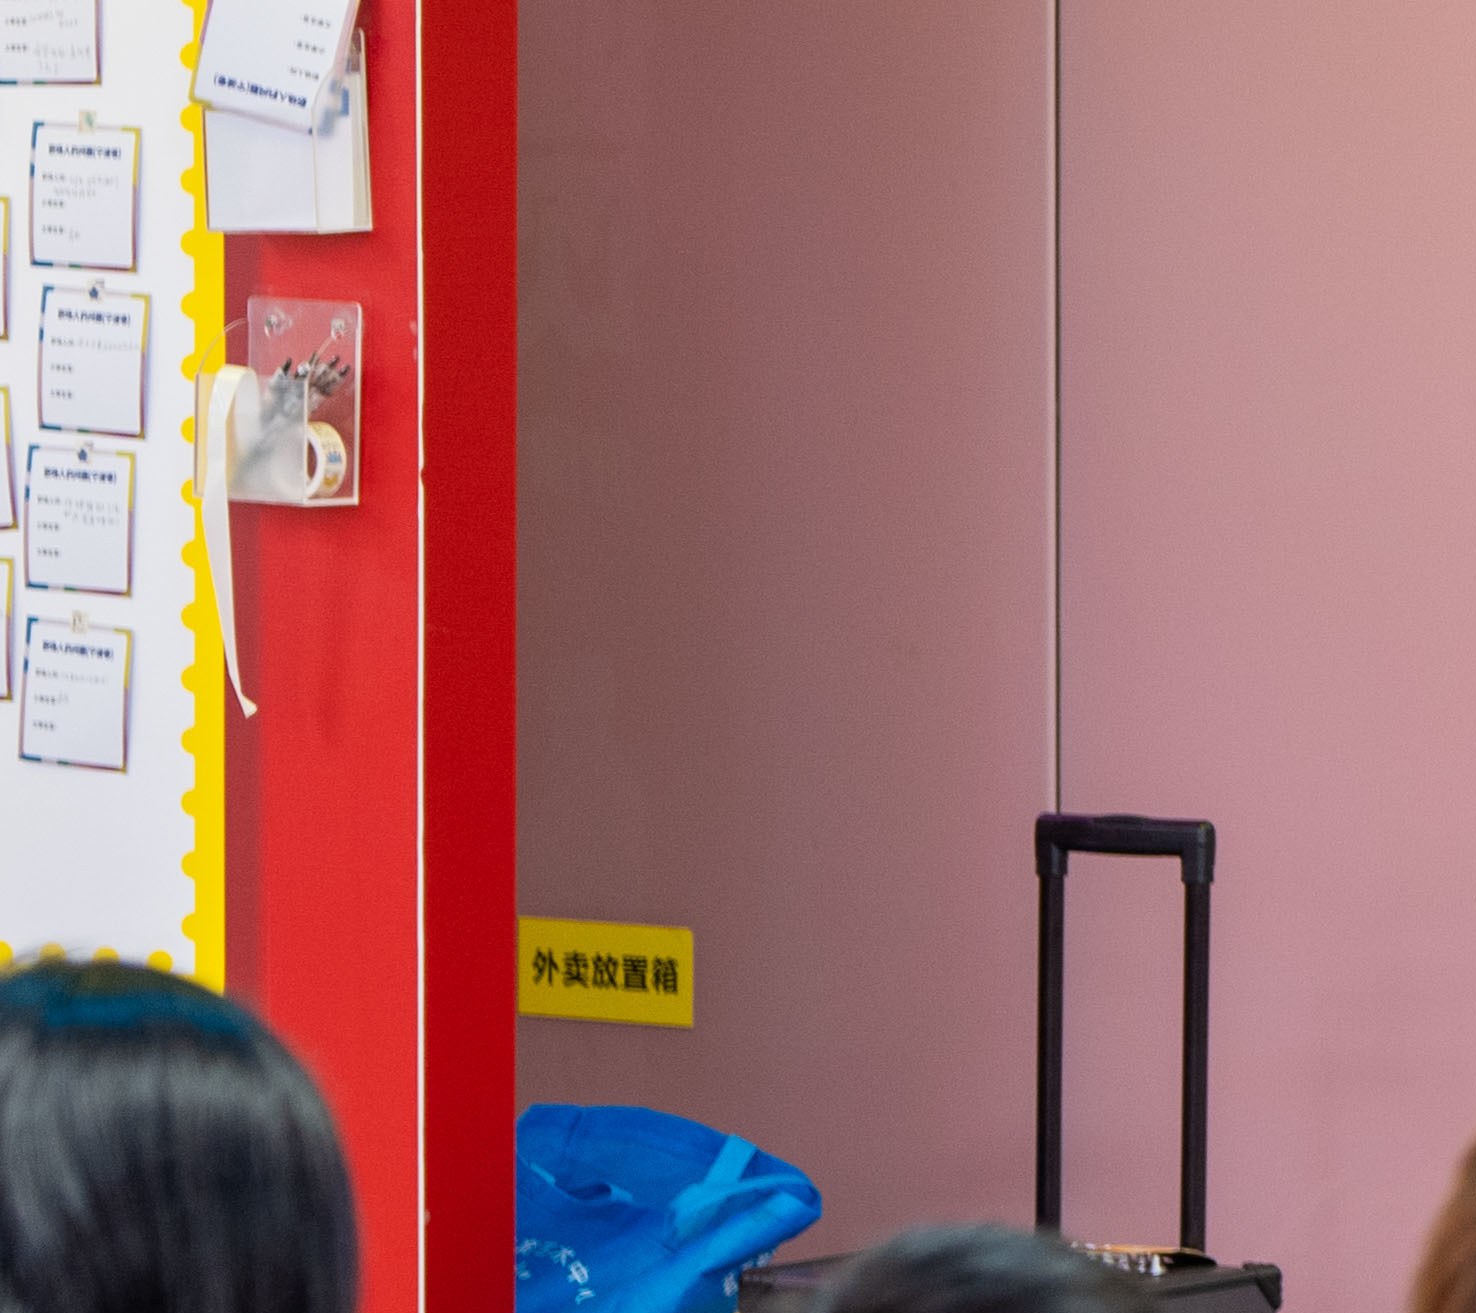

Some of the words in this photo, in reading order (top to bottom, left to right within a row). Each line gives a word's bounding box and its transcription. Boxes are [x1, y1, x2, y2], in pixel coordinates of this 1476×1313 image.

[533, 949, 679, 995] 外卖放置箱
